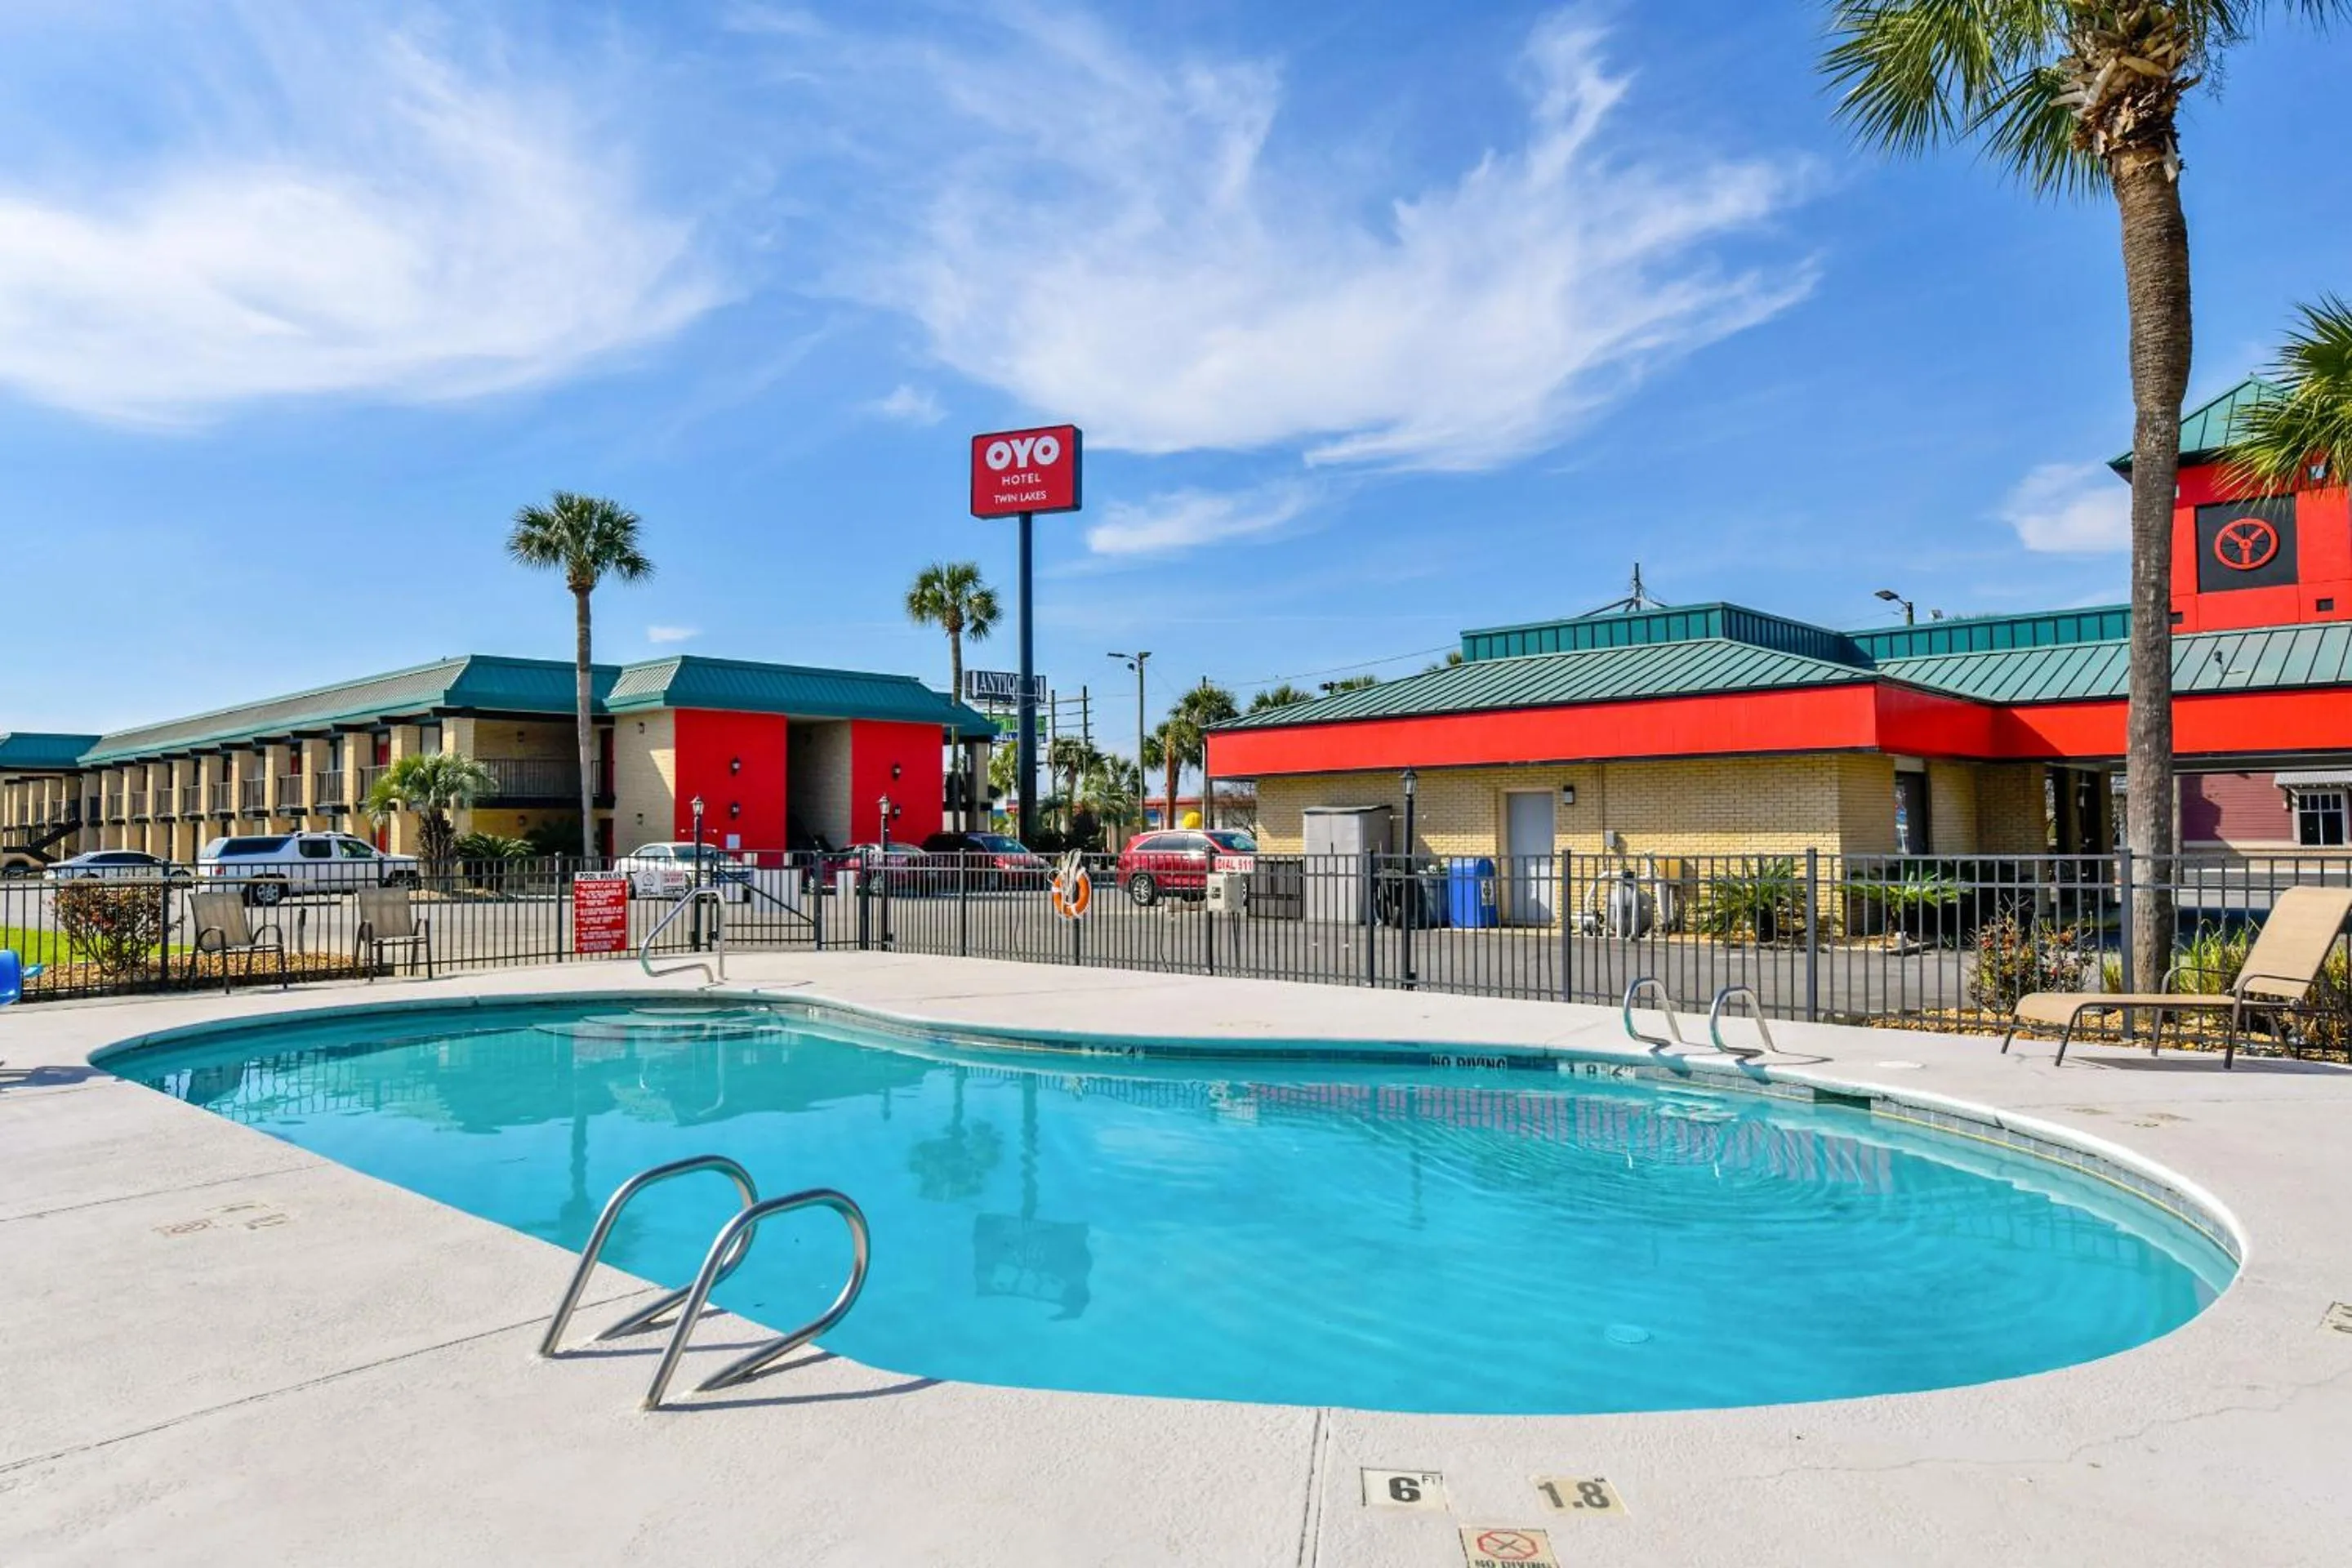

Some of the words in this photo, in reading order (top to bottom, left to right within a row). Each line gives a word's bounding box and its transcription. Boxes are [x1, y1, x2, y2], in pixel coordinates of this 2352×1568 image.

[986, 435, 1060, 470] OYO
[1001, 473, 1042, 486] HOTEL
[994, 494, 1018, 504] TWIN
[1020, 490, 1047, 502] LAKES
[979, 670, 1039, 700] ANTIQS
[1431, 1055, 1451, 1067] NO
[1456, 1056, 1507, 1069] DIVING
[1389, 1477, 1421, 1503] 6
[1538, 1481, 1610, 1508] 1.8
